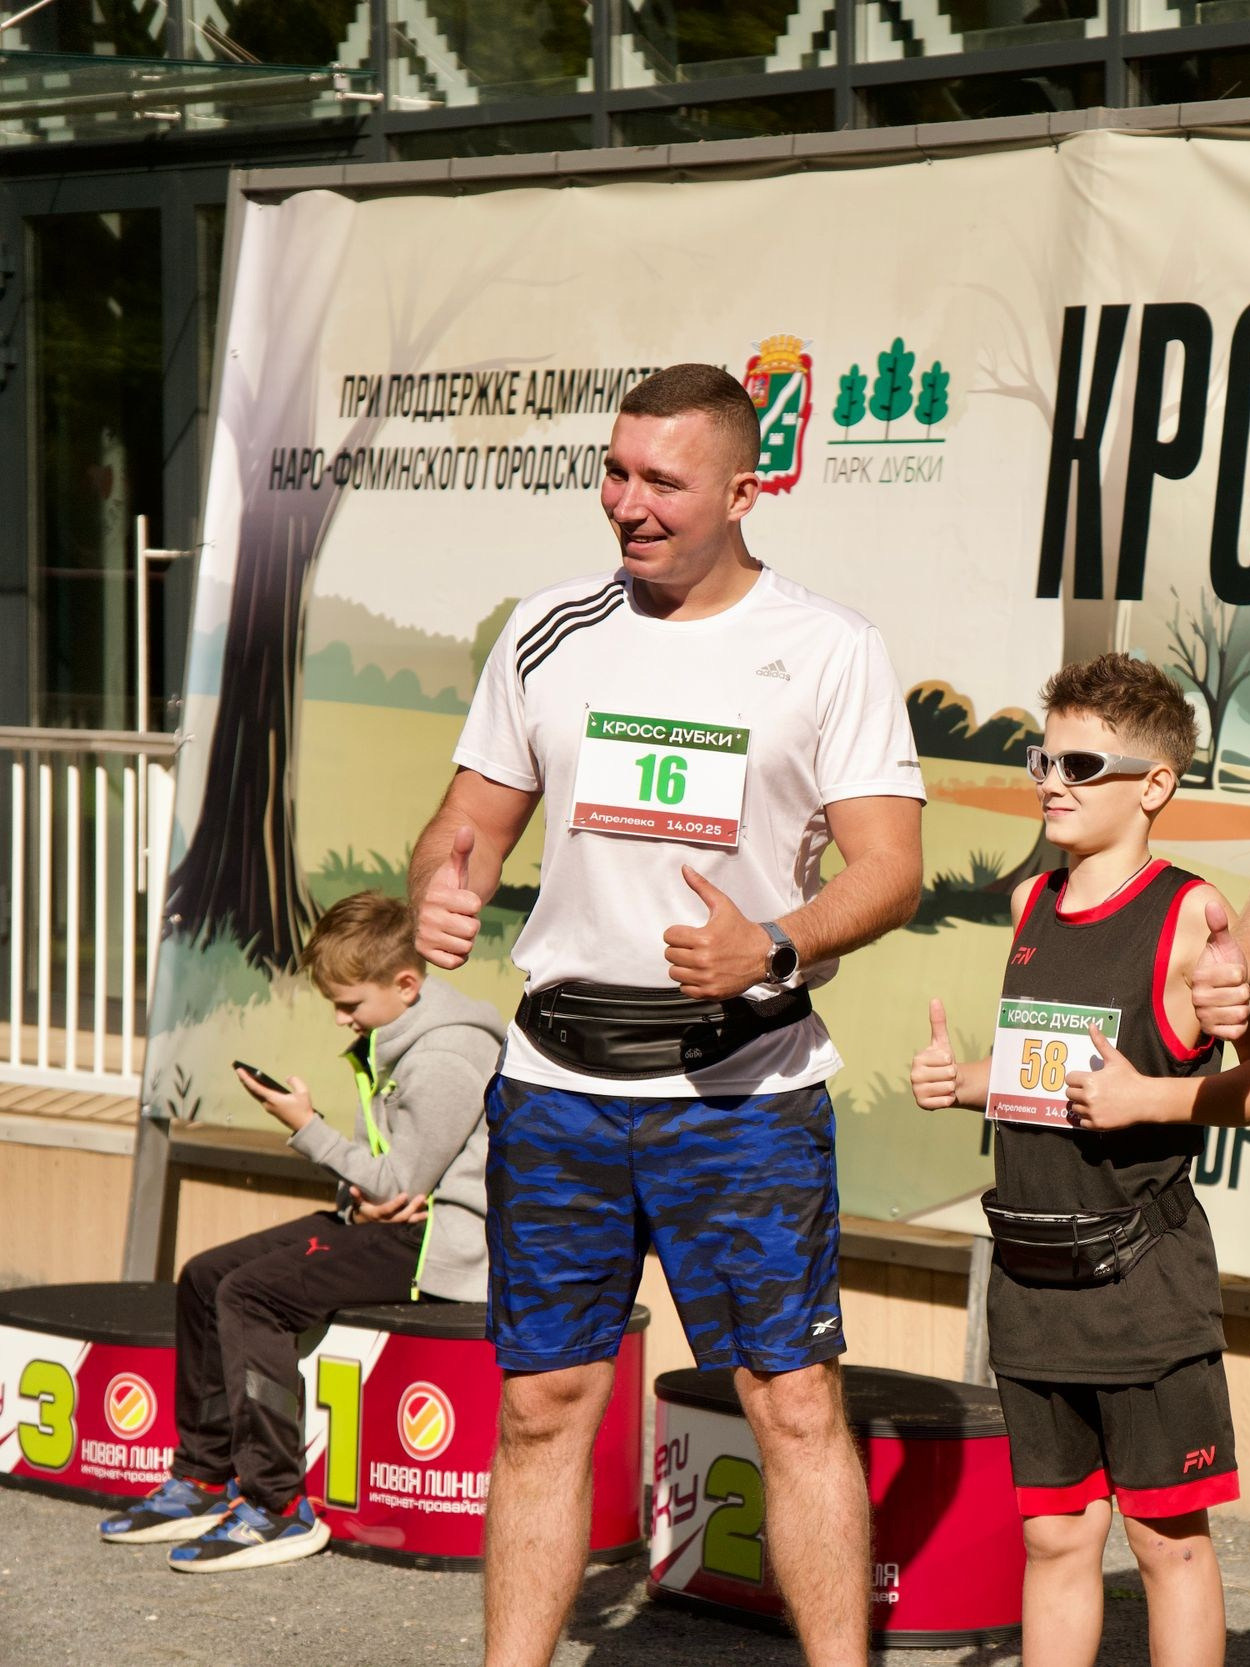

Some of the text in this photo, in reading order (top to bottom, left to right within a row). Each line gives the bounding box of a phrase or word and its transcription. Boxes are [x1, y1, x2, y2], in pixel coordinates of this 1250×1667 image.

[339, 374, 382, 418] ПРИ
[384, 370, 517, 422] ПОДДЕРЖКЕ
[268, 446, 480, 491] НАРО-ФОМИНСКОГО
[823, 455, 944, 483] ПАРК ДУБКИ
[755, 669, 791, 682] adidas
[602, 720, 733, 748] КРОСС ДУБКИ
[635, 753, 688, 805] 16
[589, 811, 722, 836] Апрелевка 14.09.25
[1007, 1009, 1104, 1031] КРОСС ДУБКИ
[1020, 1038, 1068, 1092] 58
[997, 1101, 1037, 1115] Апрелевка
[18, 1358, 77, 1470] 3
[317, 1355, 361, 1510] 1
[1183, 1445, 1216, 1474] FN
[703, 1454, 767, 1584] 2
